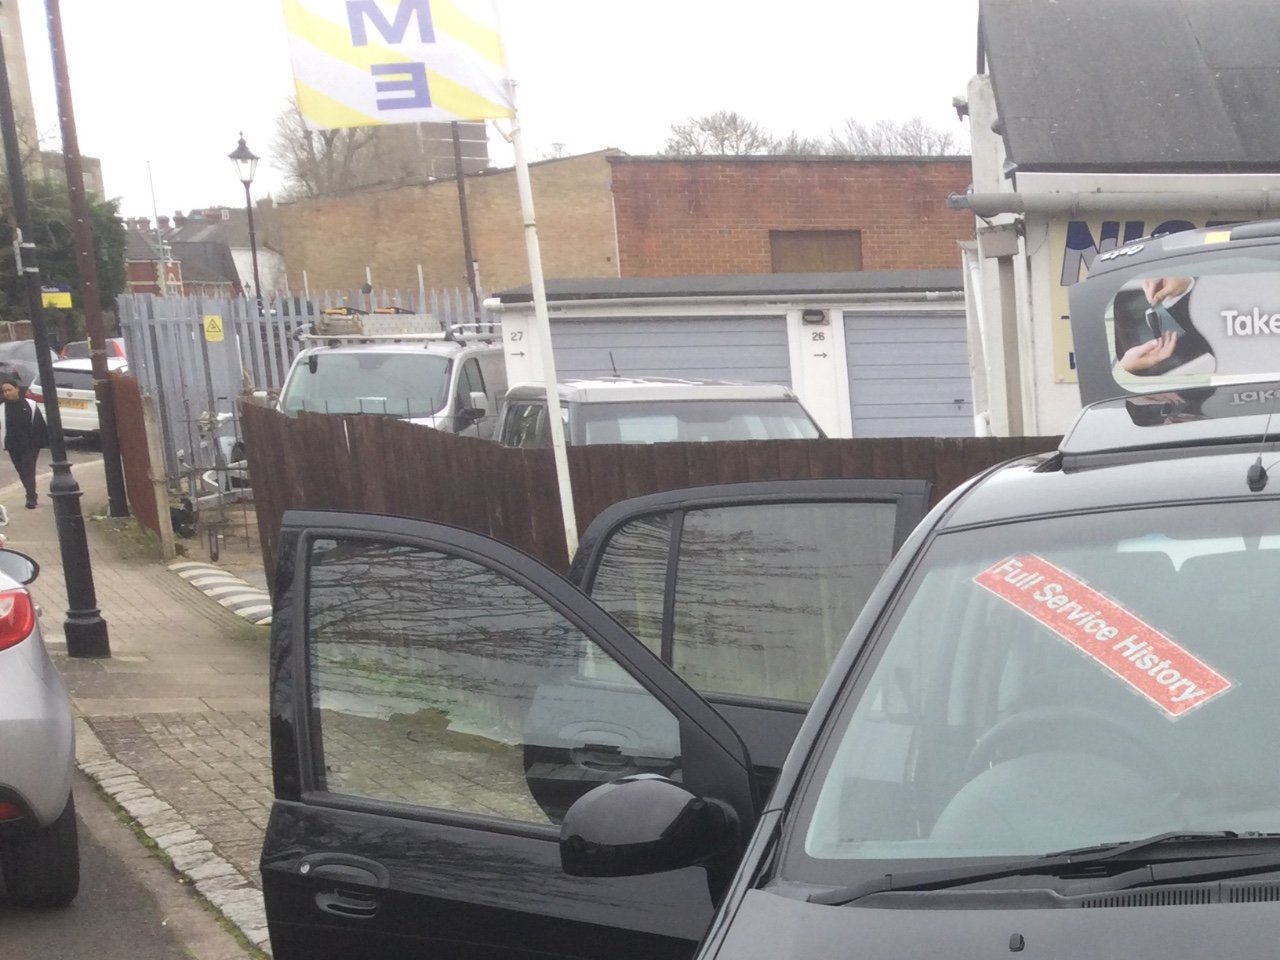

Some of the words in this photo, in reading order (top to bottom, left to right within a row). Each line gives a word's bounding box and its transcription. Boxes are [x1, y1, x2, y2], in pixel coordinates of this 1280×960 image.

[510, 332, 524, 342] 27
[811, 332, 826, 342] 26
[994, 558, 1044, 590] Full
[1033, 583, 1118, 641] Service
[1112, 635, 1205, 703] History
